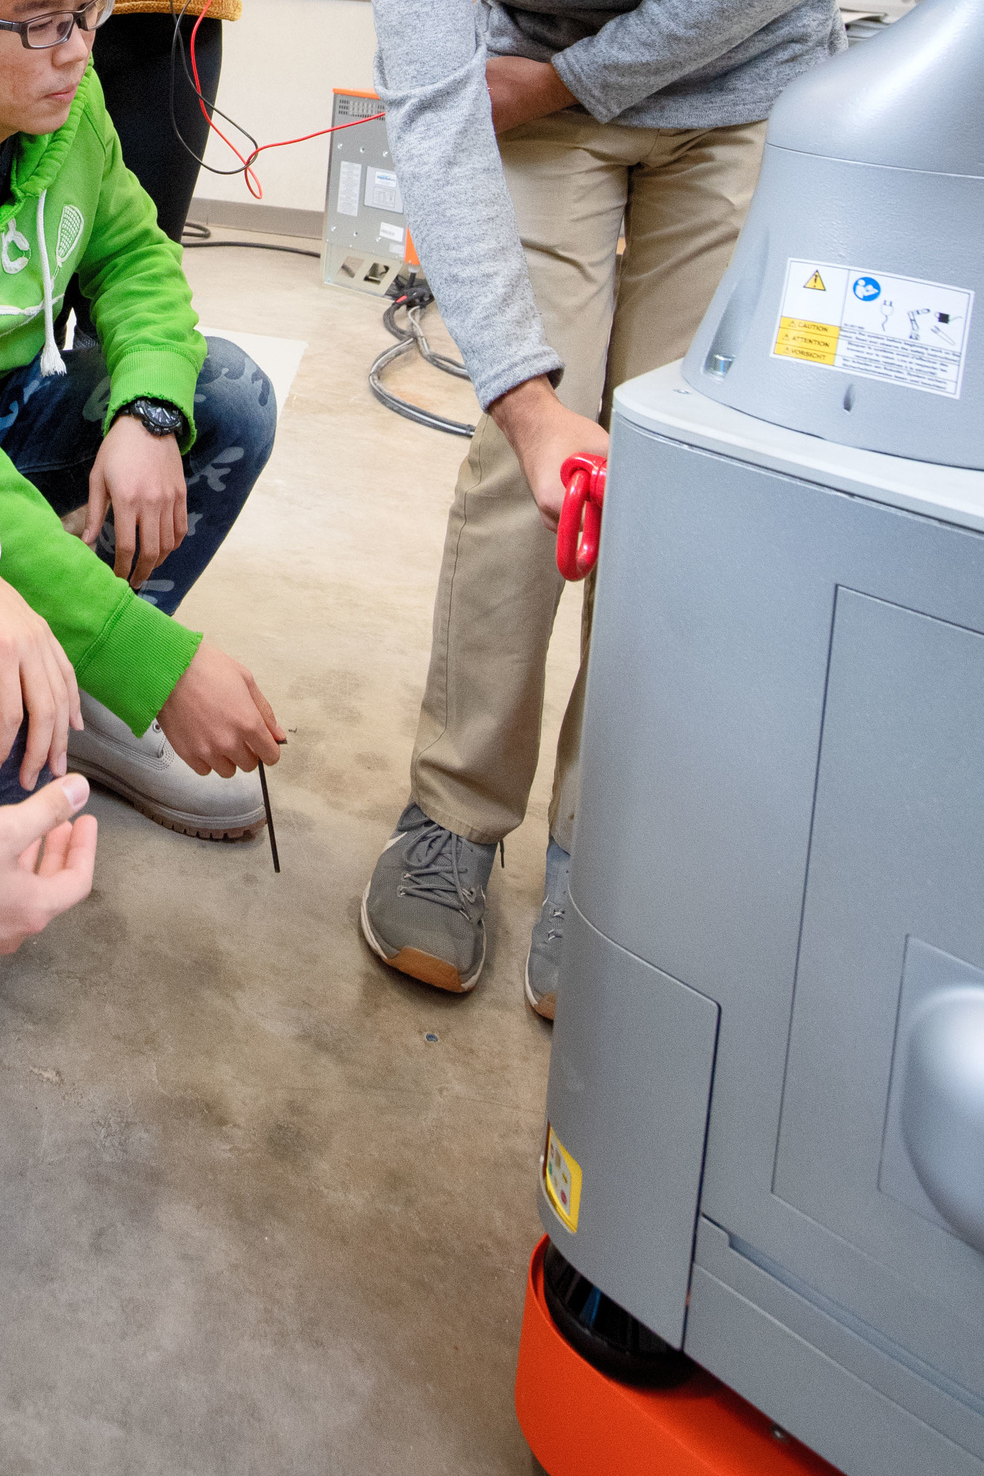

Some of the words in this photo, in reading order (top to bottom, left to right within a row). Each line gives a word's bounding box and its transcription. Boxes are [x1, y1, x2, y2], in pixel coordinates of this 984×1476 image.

[798, 322, 828, 332] CAUTION
[792, 336, 830, 347] ATTENTION
[791, 349, 826, 360] VORSICHT
